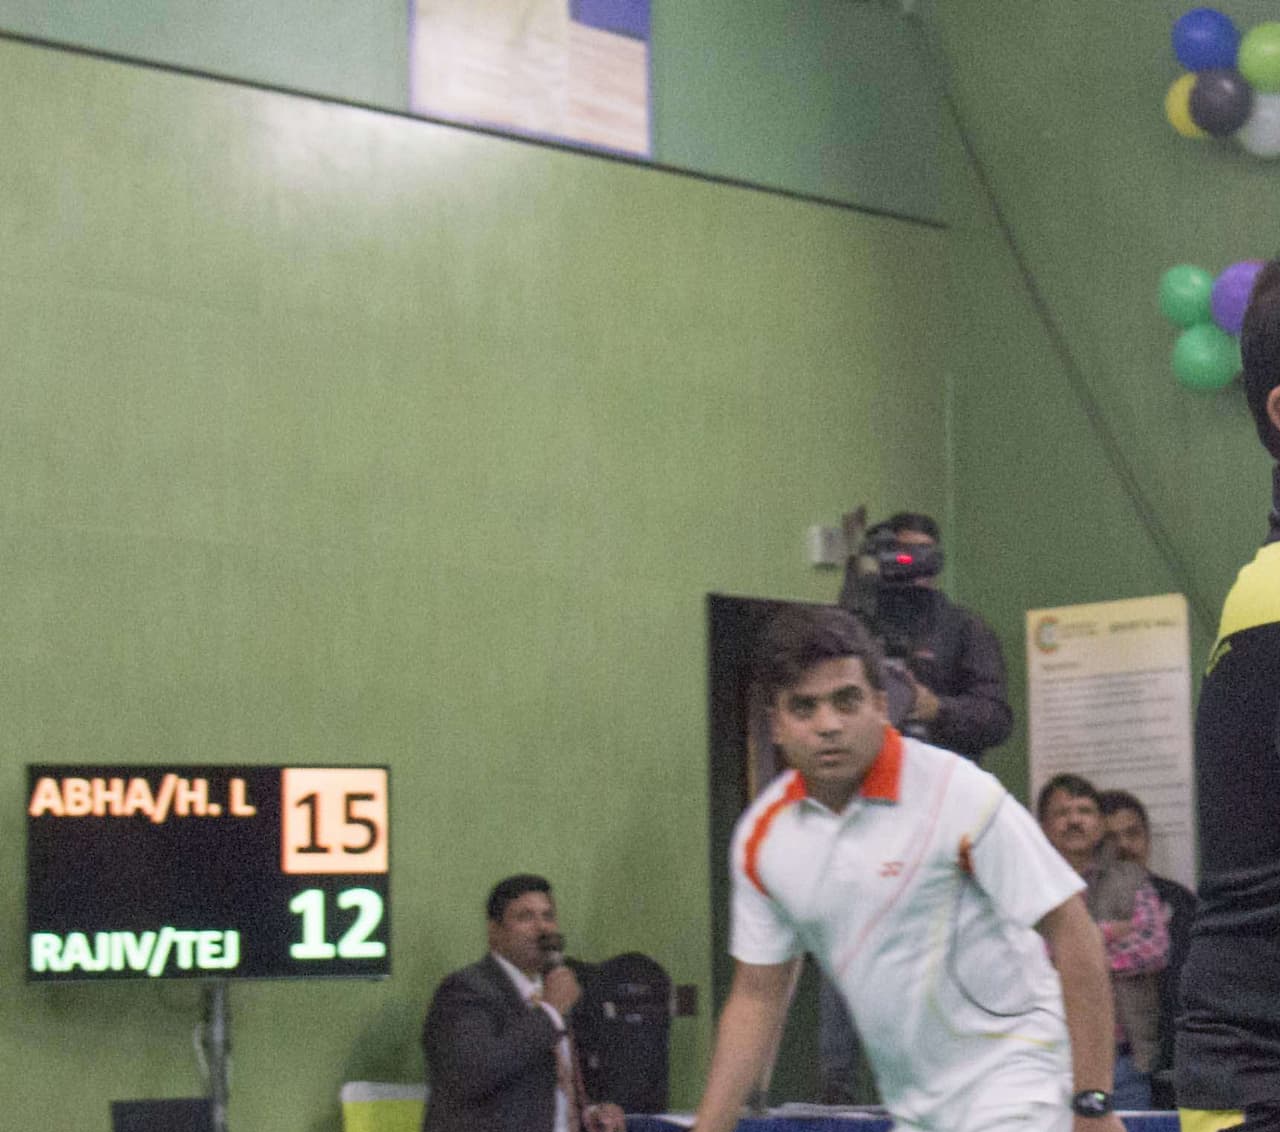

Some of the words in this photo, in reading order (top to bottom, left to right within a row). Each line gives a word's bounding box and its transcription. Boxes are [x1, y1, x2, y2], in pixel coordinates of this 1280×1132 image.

[29, 773, 221, 824] ABHA/H.
[229, 778, 256, 817] L
[294, 792, 380, 854] 15
[30, 926, 240, 977] RAJIV/TEJ
[289, 888, 387, 960] 12
